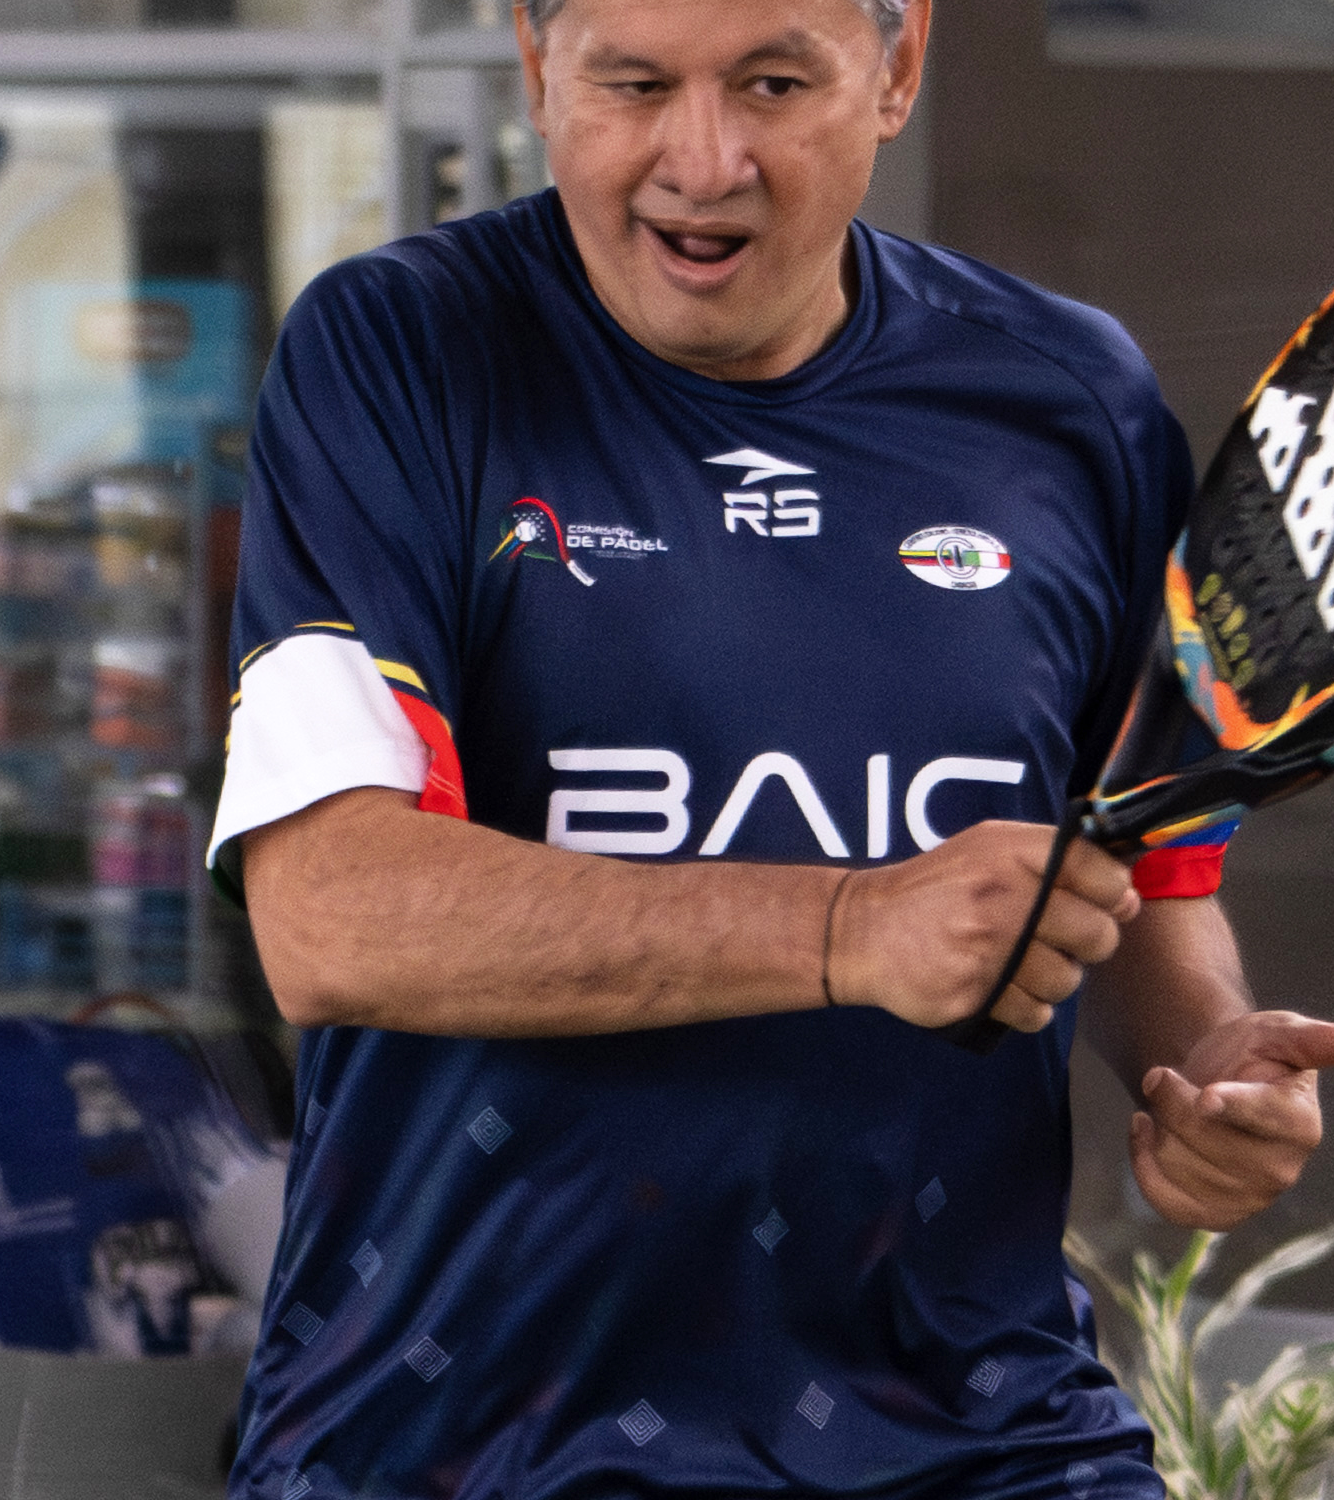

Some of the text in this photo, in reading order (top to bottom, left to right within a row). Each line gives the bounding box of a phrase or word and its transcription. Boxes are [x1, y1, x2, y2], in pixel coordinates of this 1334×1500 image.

[723, 490, 820, 537] RS
[566, 535, 595, 548] DE
[547, 748, 1025, 858] BAIC
